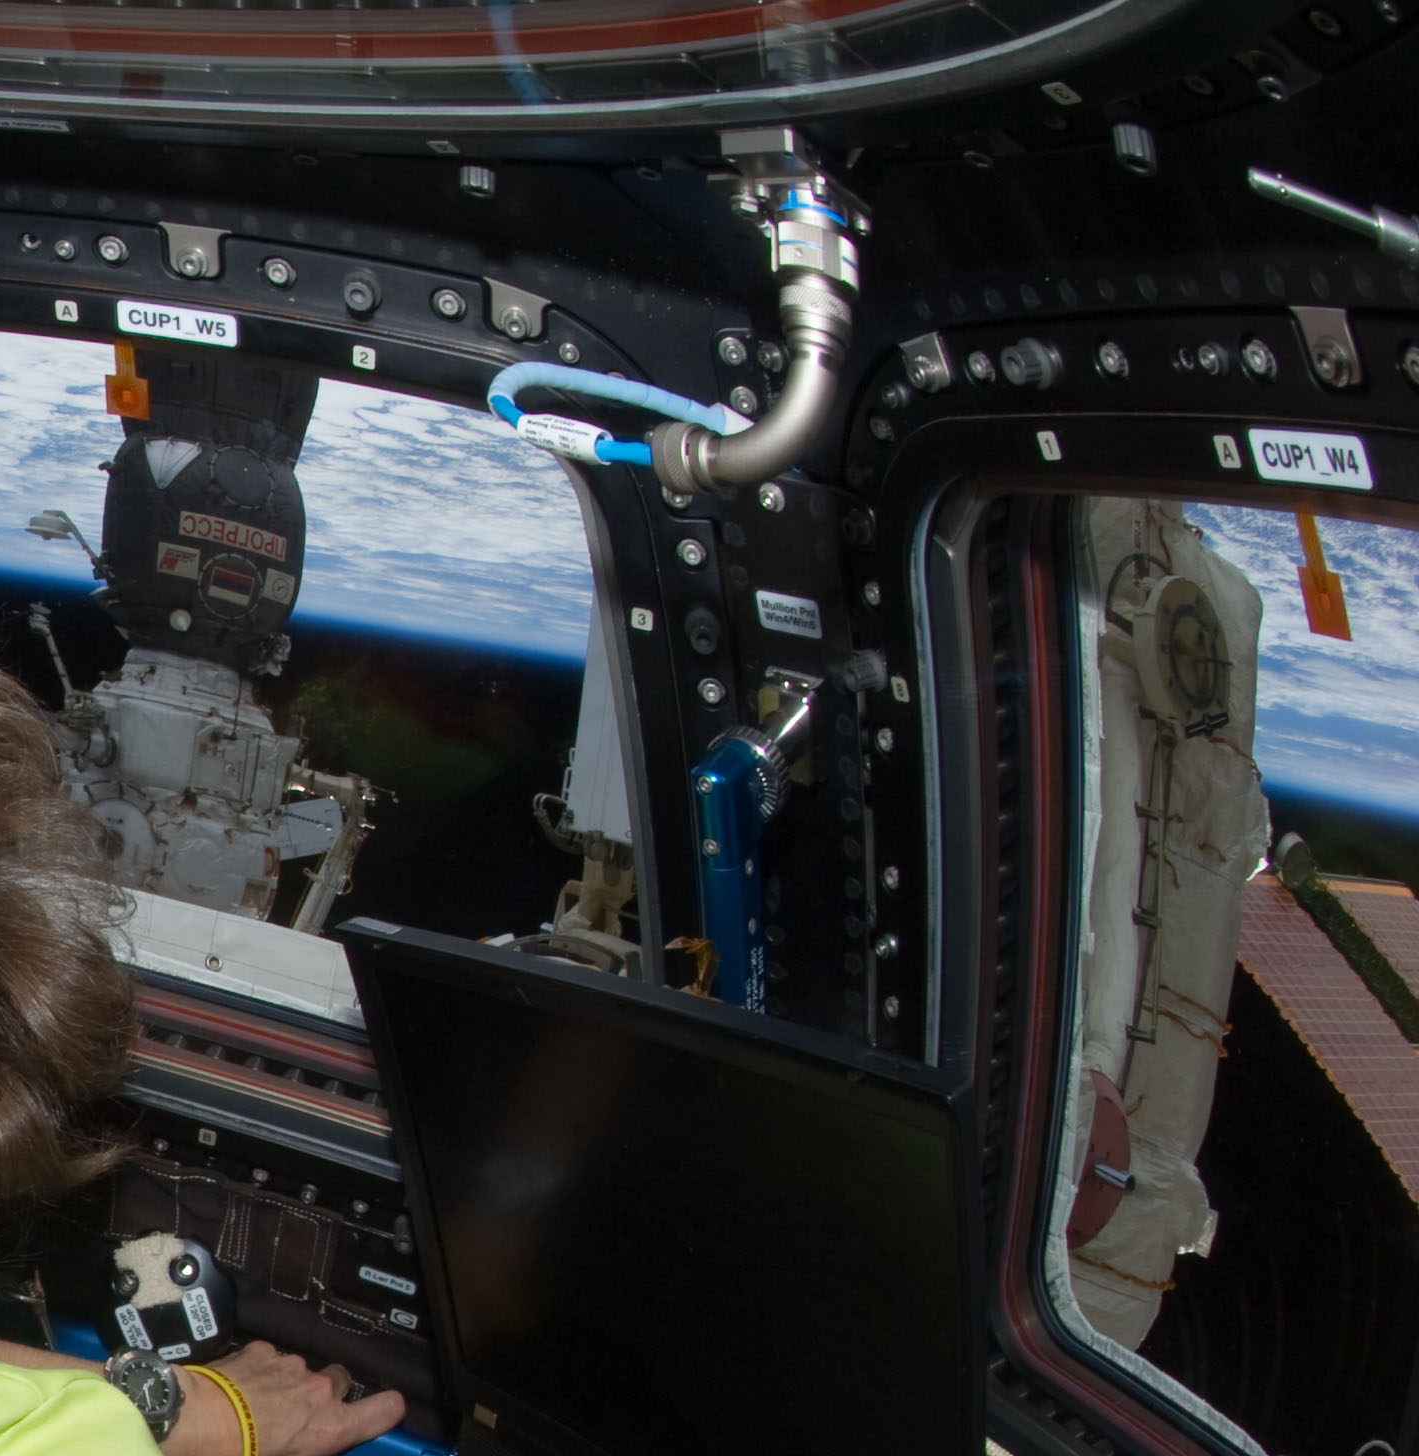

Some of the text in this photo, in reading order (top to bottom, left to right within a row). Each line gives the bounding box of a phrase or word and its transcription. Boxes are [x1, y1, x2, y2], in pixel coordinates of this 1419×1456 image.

[61, 304, 73, 318] A
[128, 307, 228, 338] CUP1_W5
[357, 350, 369, 364] 2
[1044, 438, 1054, 455] 1
[1223, 444, 1235, 462] A
[1262, 443, 1361, 475] CUP1_W4
[182, 514, 287, 561] ПРОГРЕСС
[761, 598, 817, 619] Mullion Pnl
[637, 612, 648, 625] 3
[764, 611, 817, 631] Win4/Win5
[203, 1132, 211, 1142] B
[119, 1313, 129, 1326] OP
[126, 1308, 136, 1322] OP
[185, 1292, 194, 1304] or
[196, 1325, 207, 1339] OP
[195, 1293, 213, 1332] CLOSED
[394, 1311, 415, 1326] G
[175, 1347, 188, 1355] CL
[233, 1382, 252, 1421] LOVES
